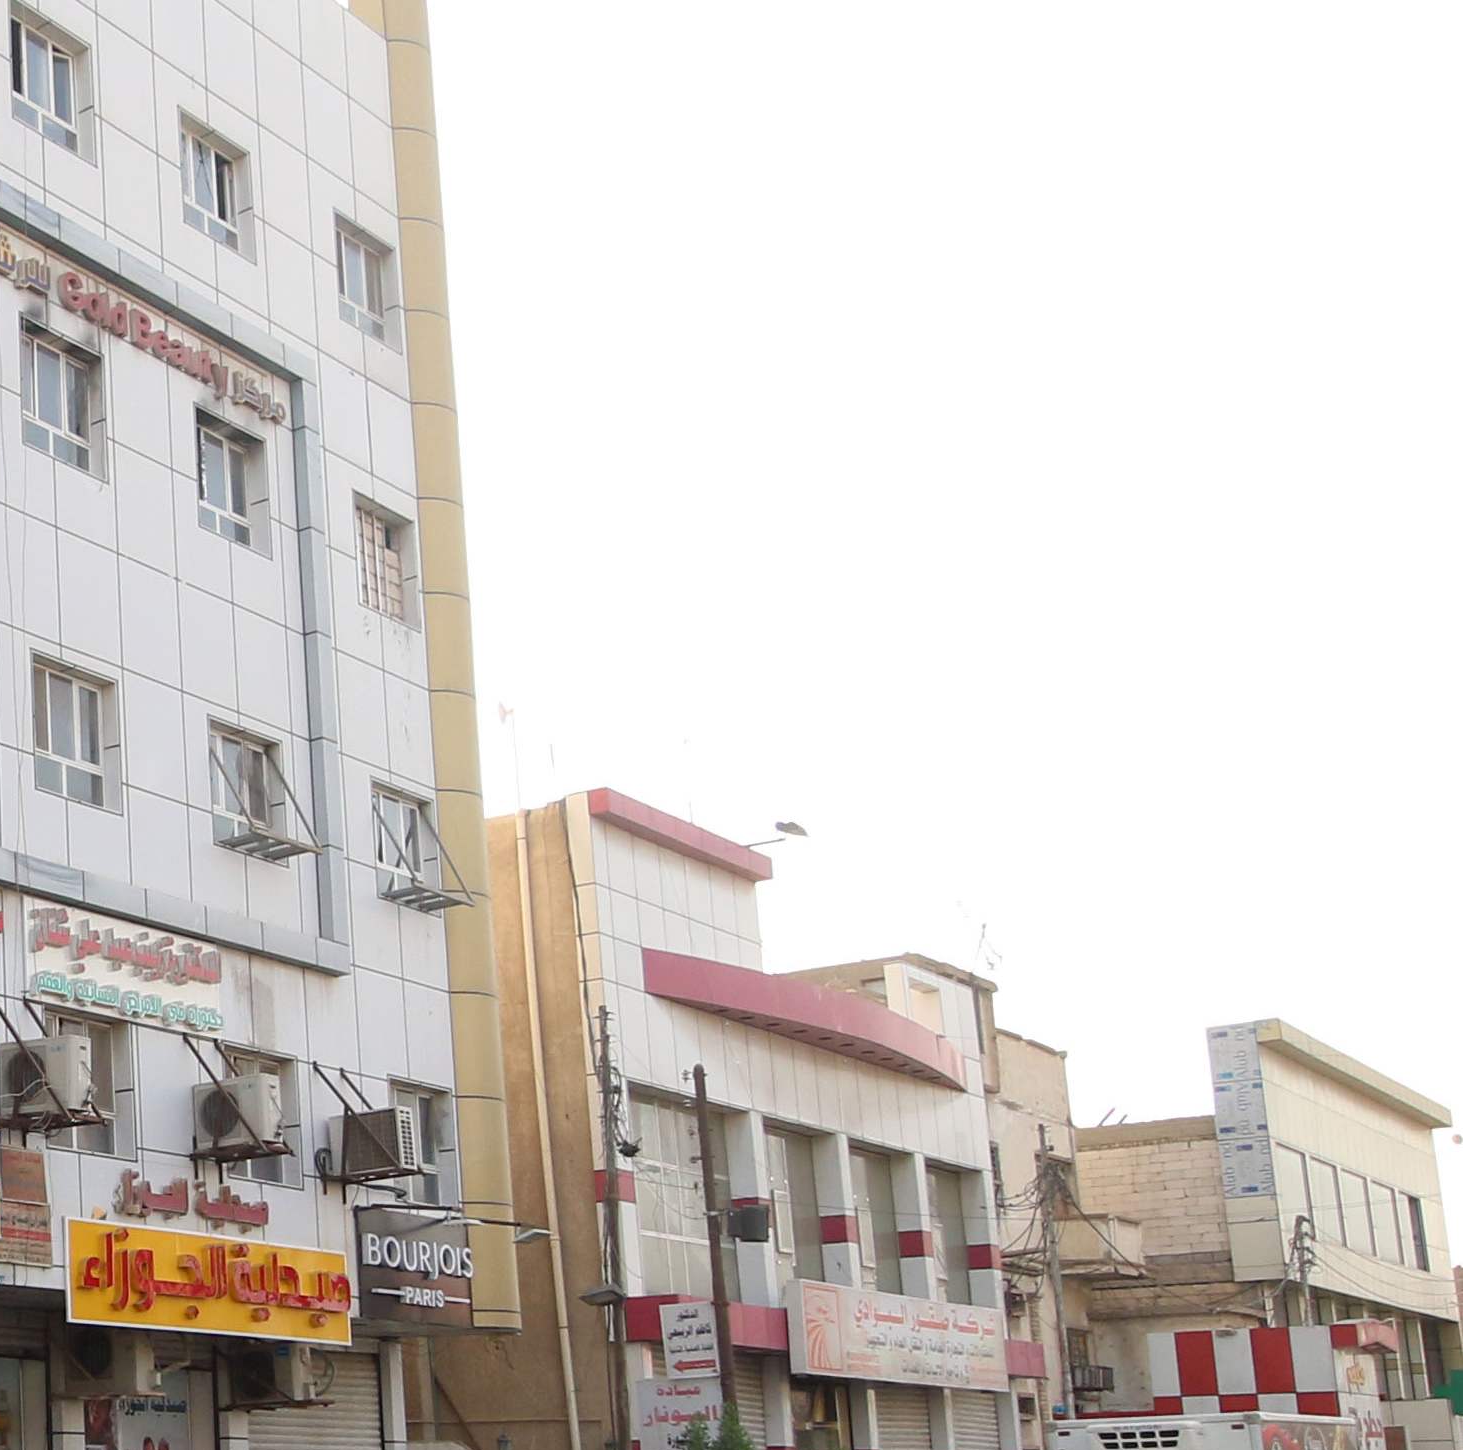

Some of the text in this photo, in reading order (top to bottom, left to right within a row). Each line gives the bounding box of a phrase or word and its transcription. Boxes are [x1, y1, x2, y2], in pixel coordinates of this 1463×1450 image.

[81, 1228, 227, 1321] الجوزاء
[232, 1243, 351, 1328] صيدلية
[363, 1233, 473, 1280] BOURJOIS
[400, 1286, 445, 1307] PARIS
